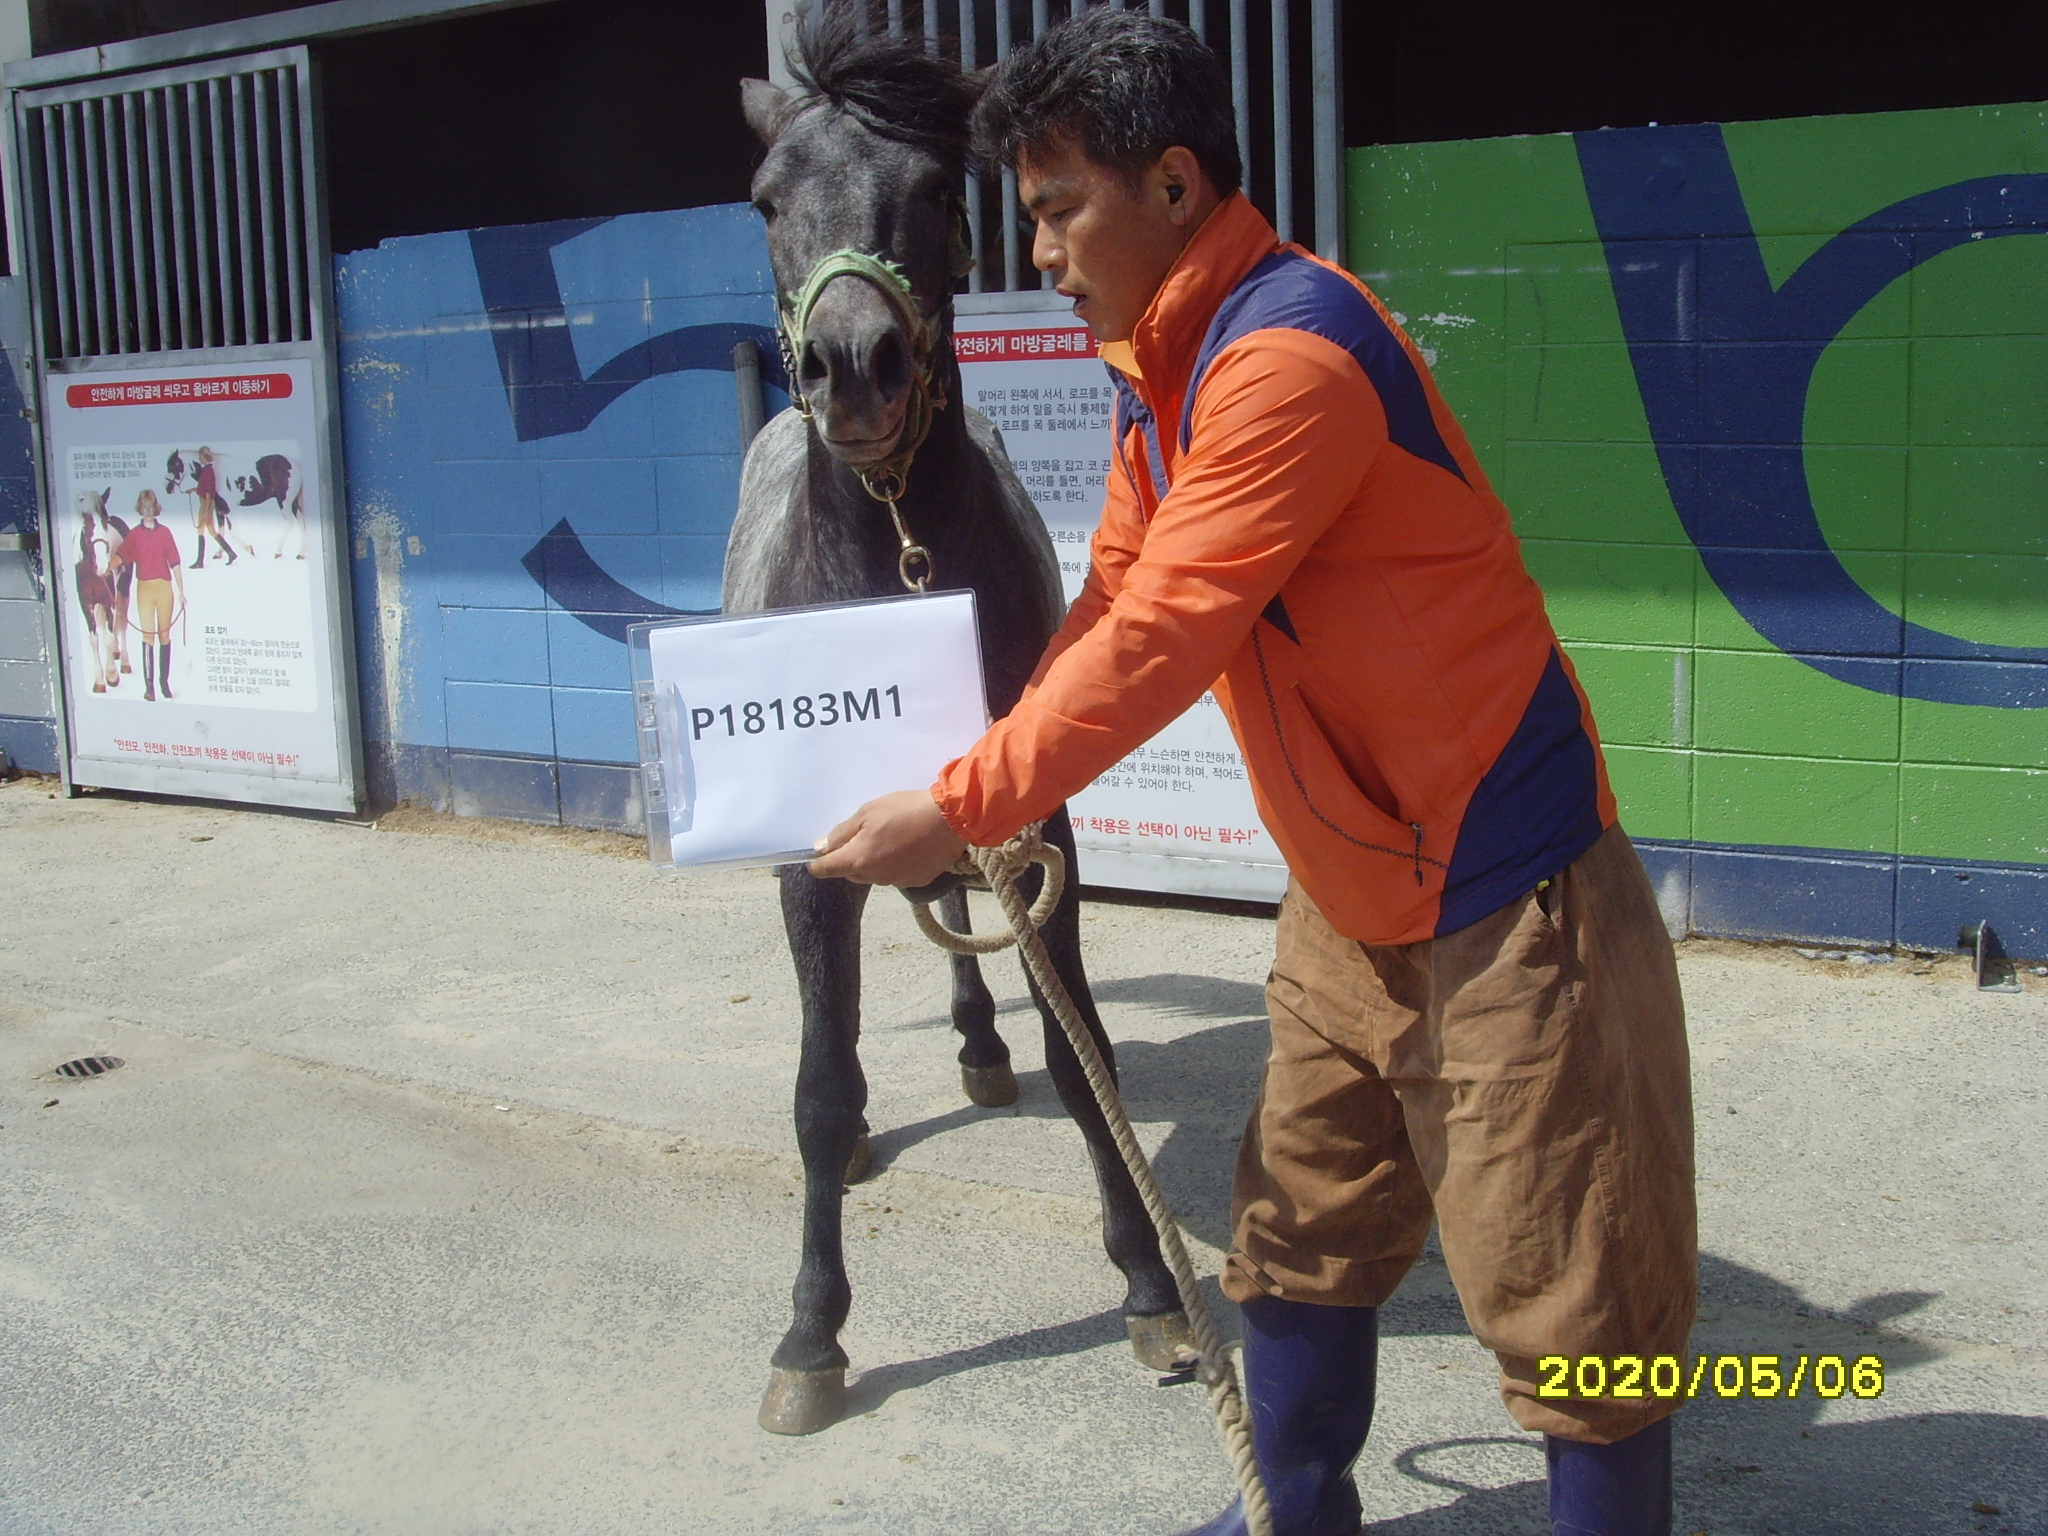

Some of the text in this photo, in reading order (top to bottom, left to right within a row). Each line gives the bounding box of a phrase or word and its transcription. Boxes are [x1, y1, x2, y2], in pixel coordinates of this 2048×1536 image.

[1011, 332, 1088, 354] 마방굴레를
[91, 378, 270, 402] 안전하게 마방굴레 씌우고 올바르게 이동하기
[977, 389, 1006, 402] 말머리
[1010, 388, 1039, 401] 왼쪽에
[1069, 387, 1099, 399] 로프를
[978, 402, 1110, 417] 이렇게 하여 말을 즉시 통제할
[1001, 418, 1113, 431] 로프를 목 둘레에서 느끼
[1031, 459, 1061, 472] 양쪽을
[1065, 459, 1084, 472] 잡고
[1087, 459, 1098, 471] 코
[1026, 475, 1055, 487] 머리를
[1085, 474, 1107, 487] 머리
[1065, 489, 1088, 503] 한다.
[1059, 561, 1081, 574] 쪽에
[691, 684, 902, 741] P18183M1
[171, 744, 202, 758] 안전조끼
[204, 747, 228, 761] 착용은
[231, 749, 255, 762] 선택이
[257, 752, 274, 765] 아닌
[1150, 748, 1190, 762] 느슨하면
[1194, 750, 1236, 765] 안전하게
[1141, 762, 1181, 777] 위치해야
[1212, 767, 1244, 781] 적어도
[1124, 777, 1134, 788] 수
[1137, 777, 1169, 791] 있어야
[1172, 780, 1196, 793] 한다.
[1090, 817, 1131, 835] 착용은
[1137, 821, 1178, 839] 선택이
[1184, 824, 1213, 843] 아닌
